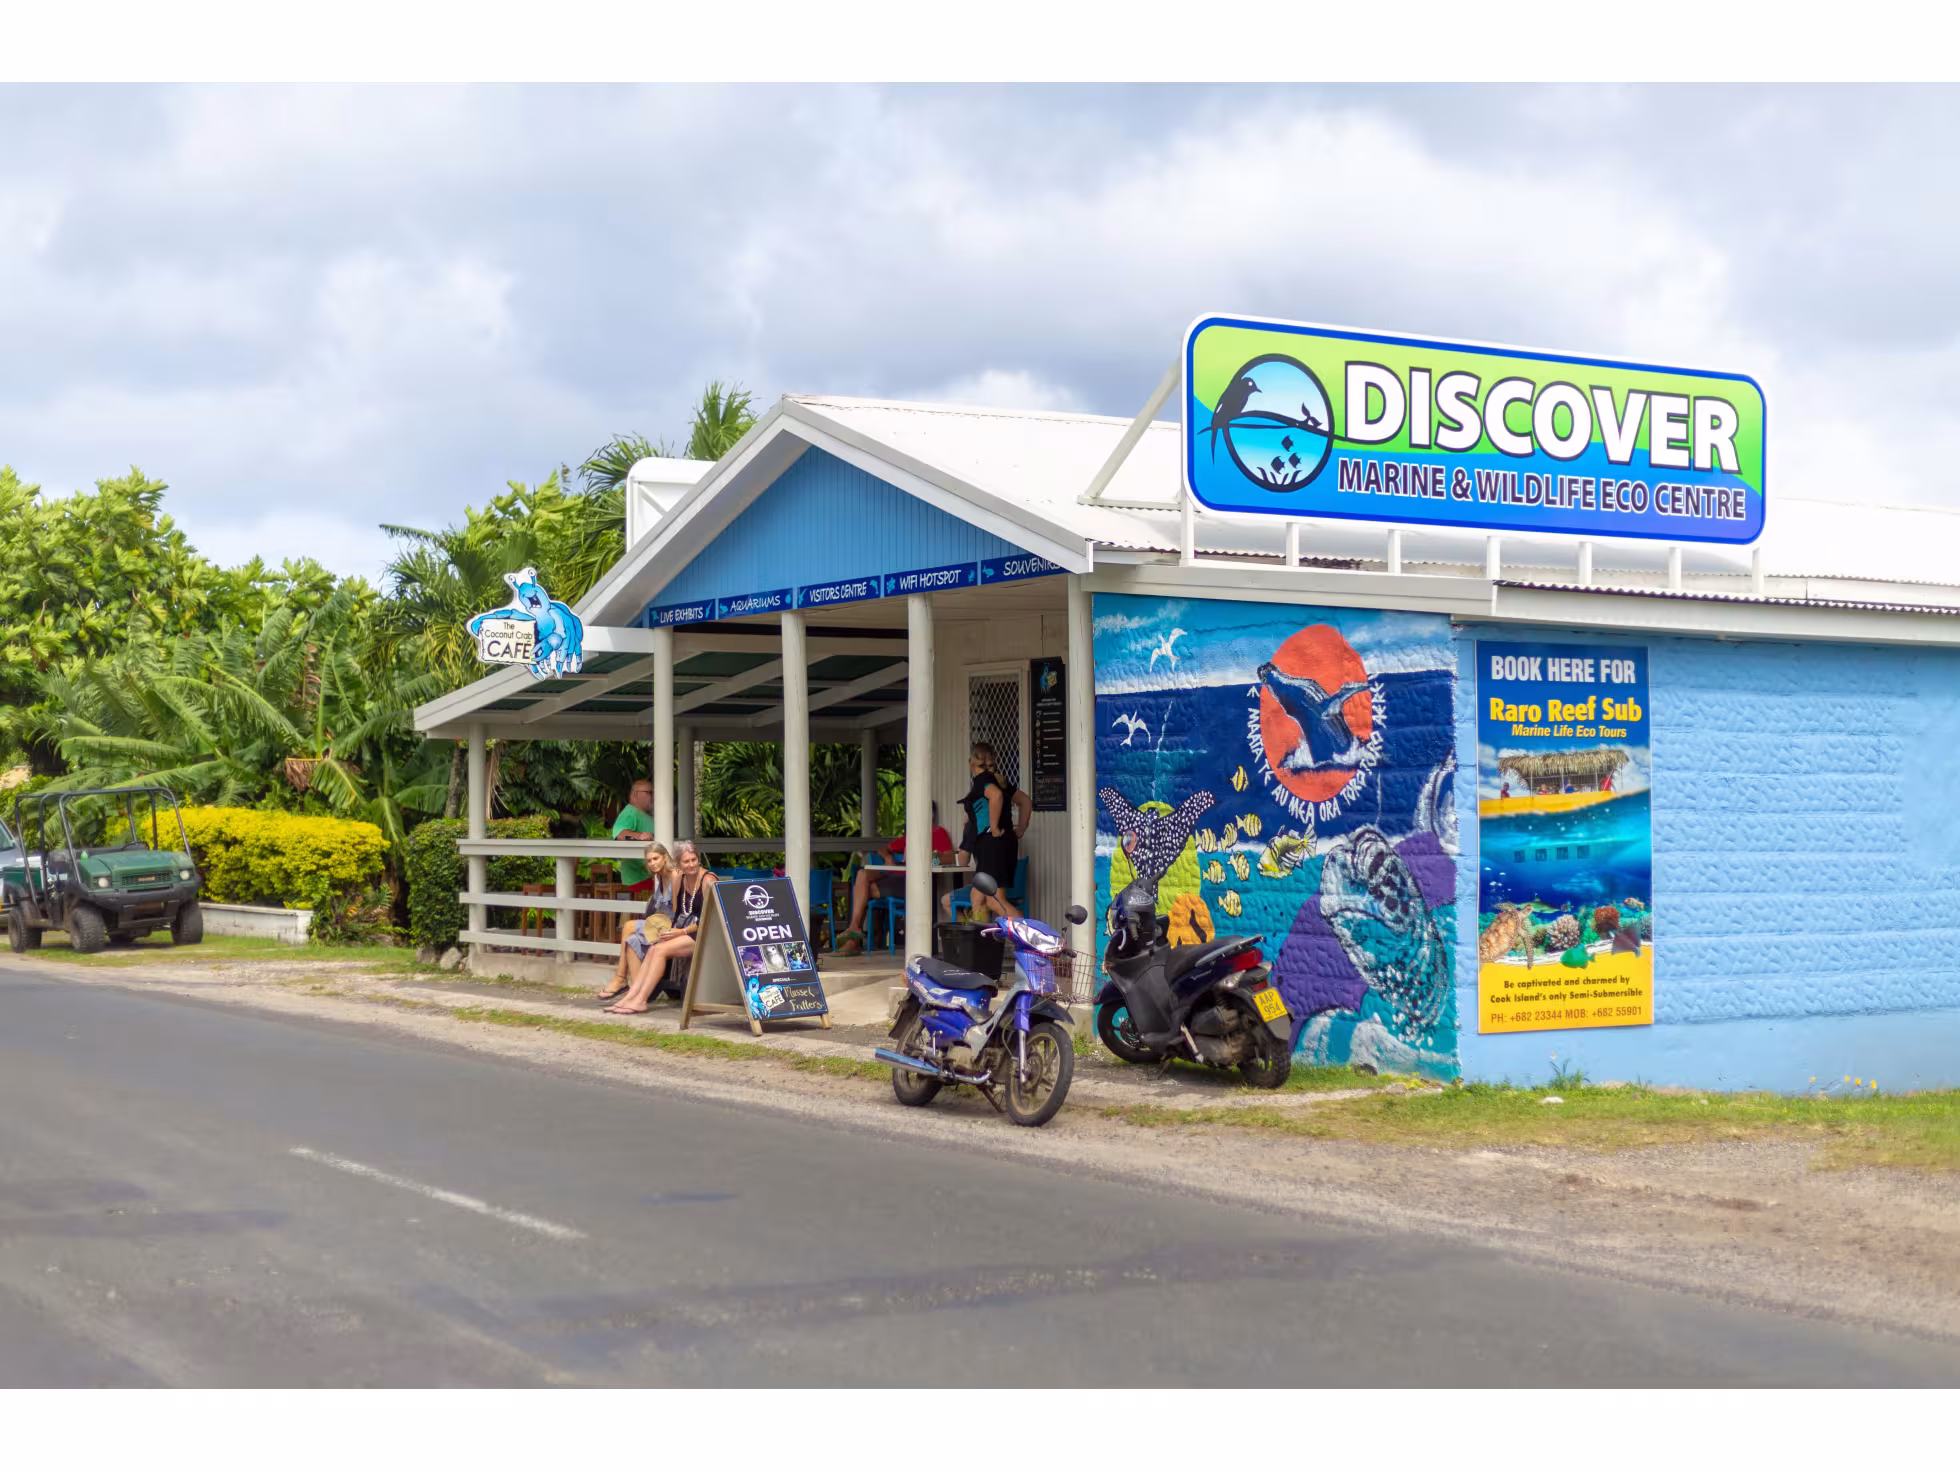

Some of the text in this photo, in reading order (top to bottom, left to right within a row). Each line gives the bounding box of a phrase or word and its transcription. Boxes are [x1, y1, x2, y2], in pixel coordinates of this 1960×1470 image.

[1344, 360, 1742, 475] DISCOVER
[1338, 457, 1746, 520] MARINE & WILDLIFE ECO CENTRE
[900, 570, 962, 590] WIFI HOTSPOT
[809, 581, 867, 602] VISITORS CENTRE
[730, 595, 781, 612] AQUARIUMS
[660, 607, 703, 623] LIVE EXHIBITS
[484, 630, 533, 640] Coconut Crab
[503, 622, 515, 630] The
[1491, 655, 1636, 683] BOOK HERE FOR
[1490, 695, 1643, 722] Raro Reef Sub
[1511, 724, 1627, 738] Marine Life Eco Tours
[1271, 783, 1288, 807] AU
[1288, 796, 1315, 826] MEA
[1319, 802, 1341, 822] ORA
[743, 924, 793, 942] OPEN
[1504, 975, 1630, 990] Be captivated and charmed by
[784, 986, 815, 998] Mussel
[1490, 988, 1643, 1003] Cook Island's only Semi-Submersible
[1491, 1006, 1642, 1024] PH: +682 23344 MOB: +682 55901
